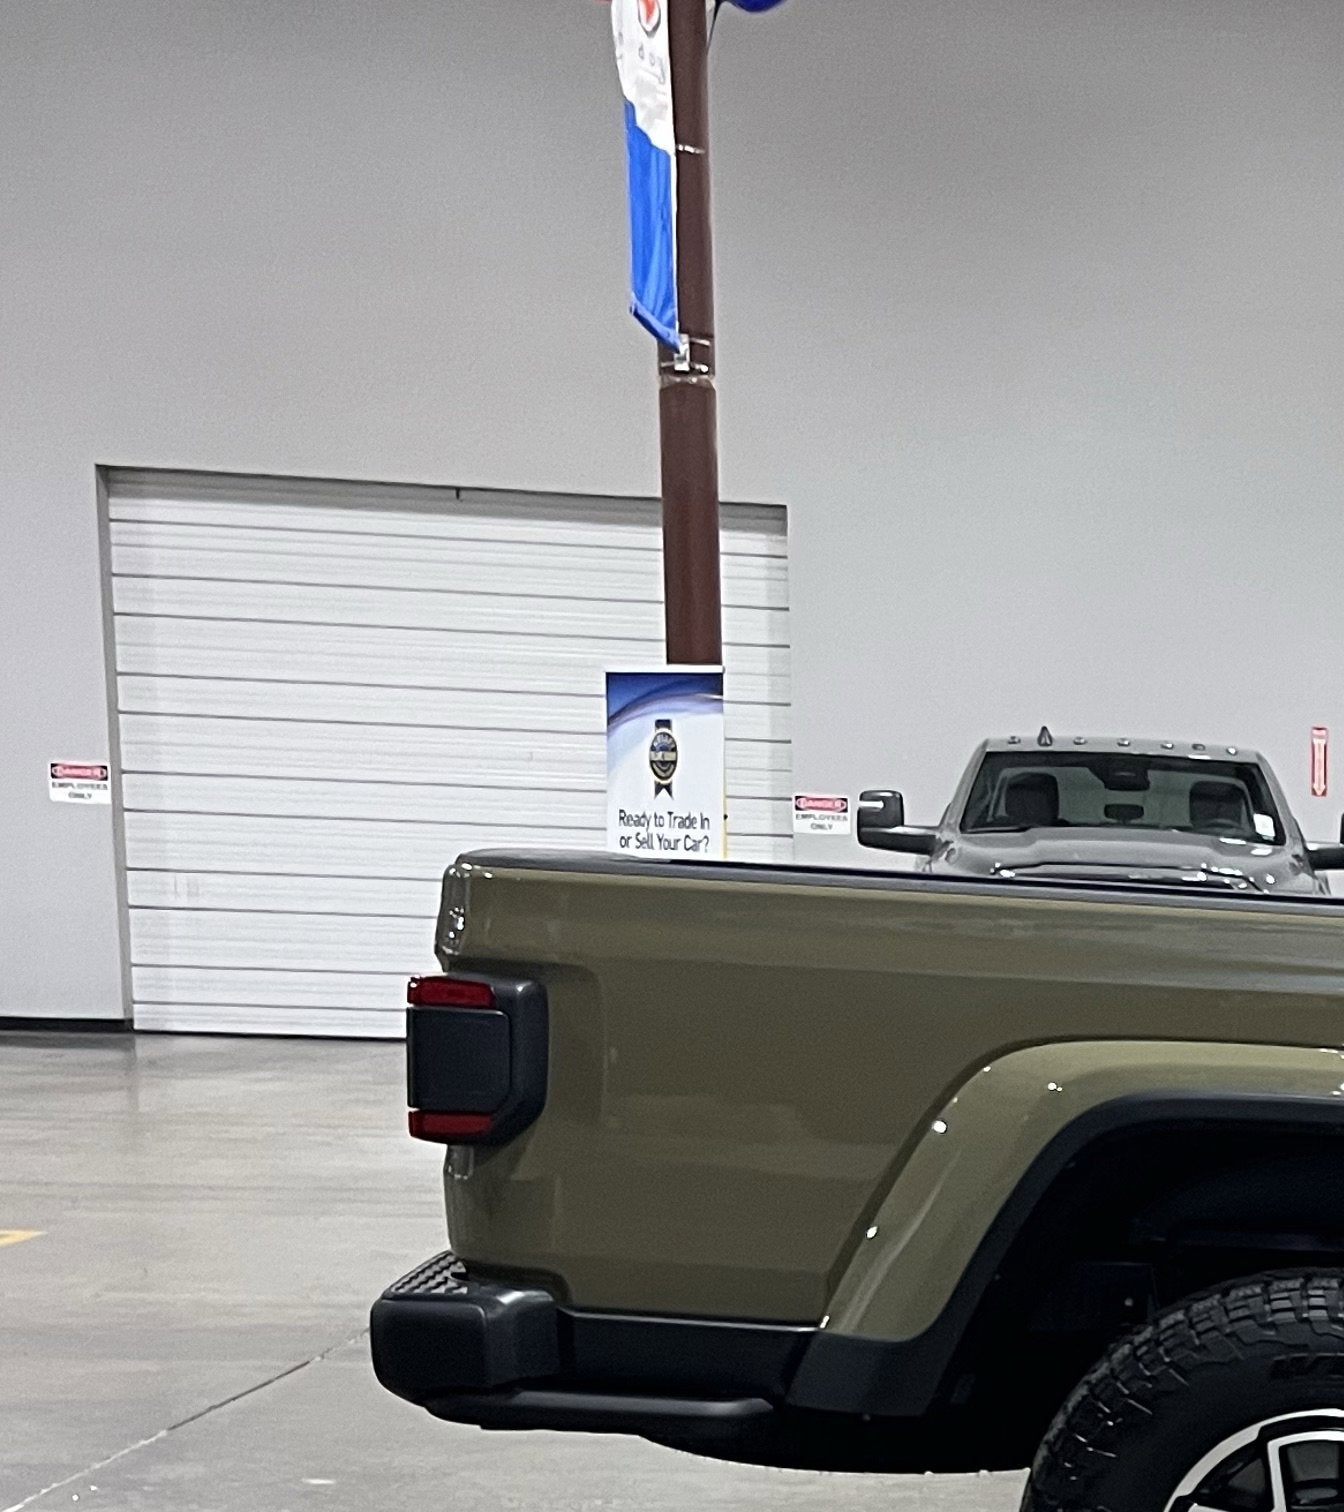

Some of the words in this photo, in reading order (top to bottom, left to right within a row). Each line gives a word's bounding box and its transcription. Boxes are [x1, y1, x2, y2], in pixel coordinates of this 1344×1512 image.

[618, 808, 652, 832] Ready
[653, 810, 665, 828] to
[667, 810, 698, 830] Trade
[700, 811, 710, 831] In
[620, 834, 633, 849] or
[635, 831, 655, 851] Sell
[657, 833, 681, 851] Your
[684, 834, 710, 853] Car?
